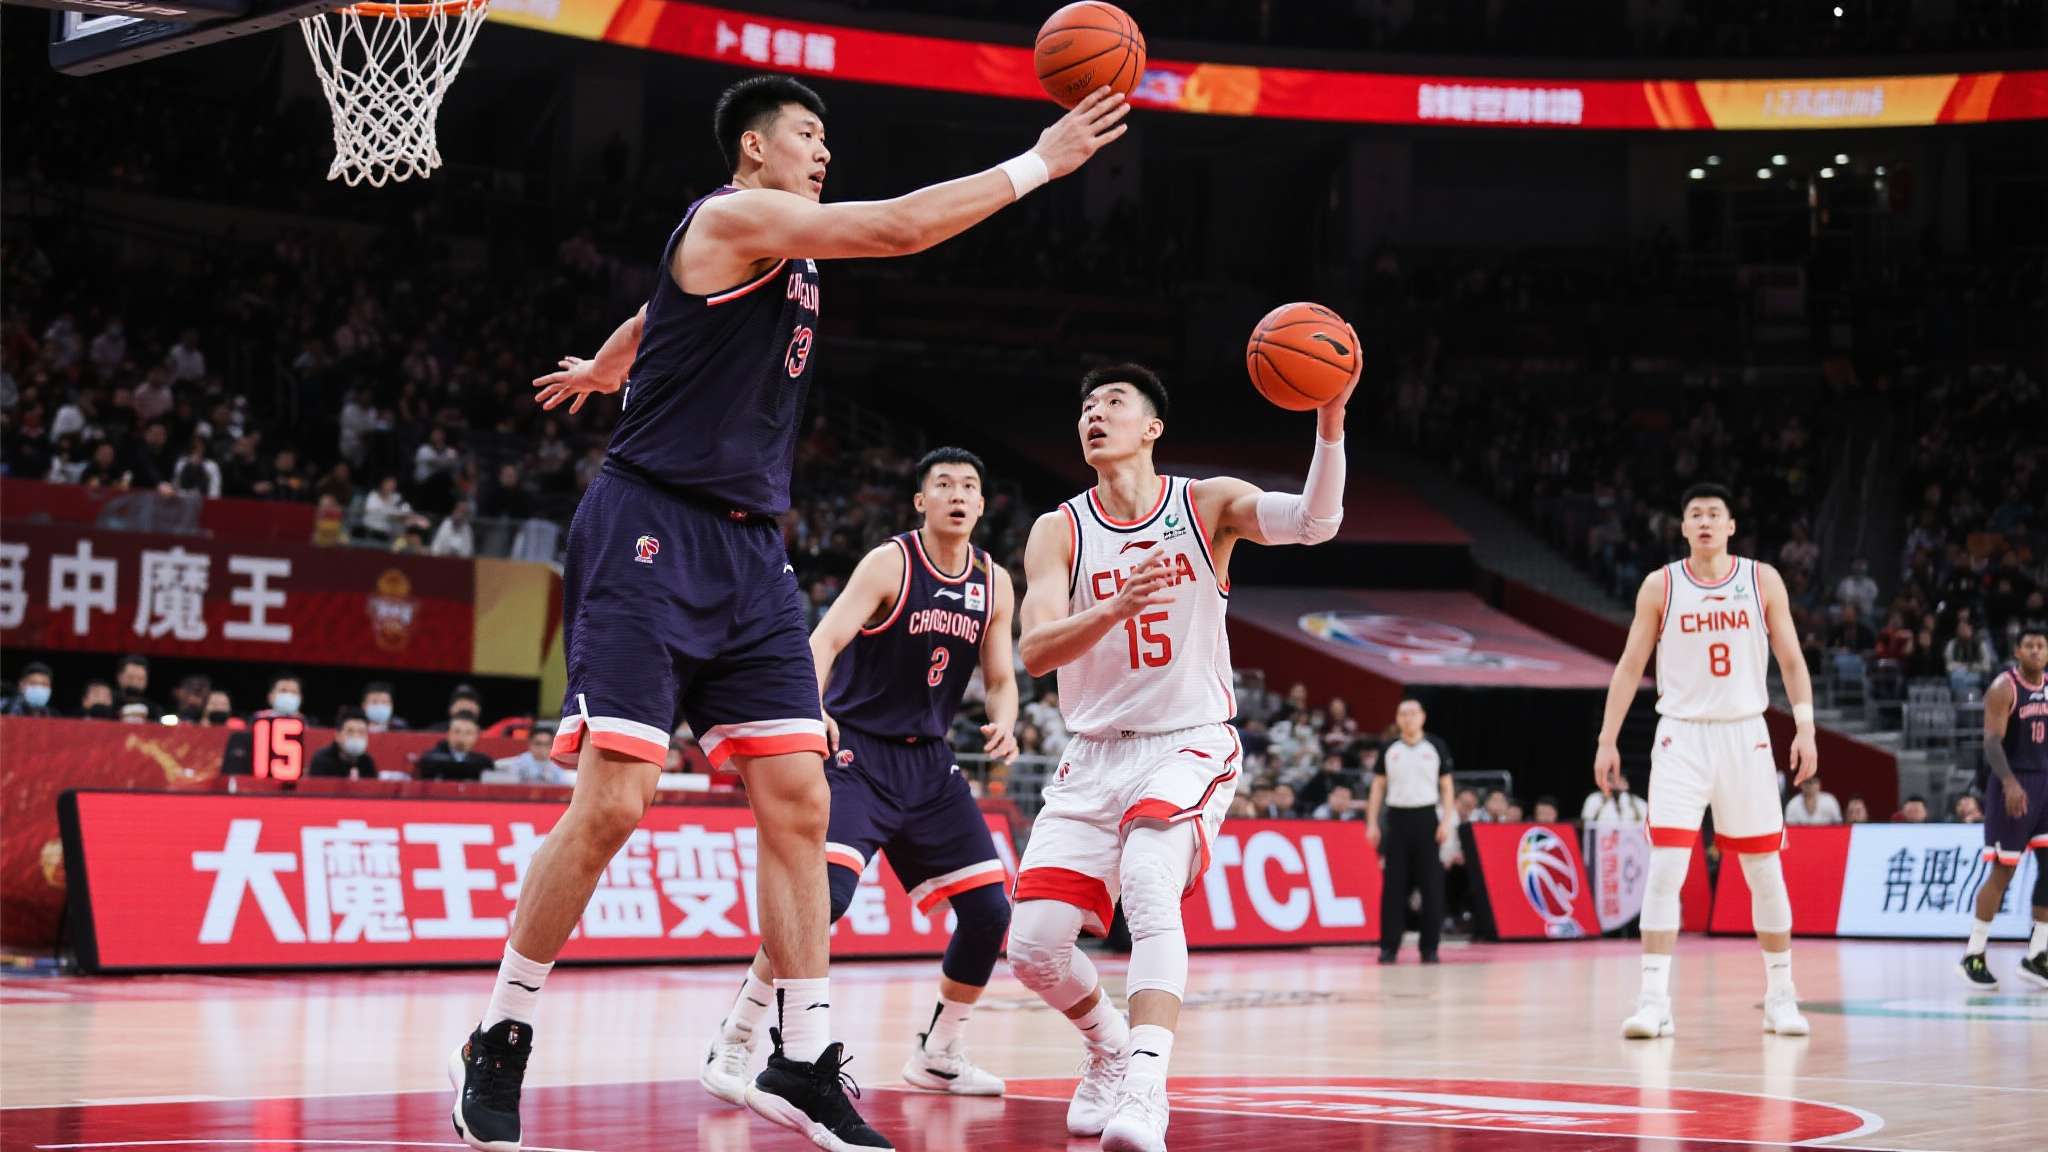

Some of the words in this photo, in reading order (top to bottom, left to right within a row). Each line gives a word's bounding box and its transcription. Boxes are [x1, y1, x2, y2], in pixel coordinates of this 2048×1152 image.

[1124, 611, 1172, 671] 15
[1680, 609, 1750, 633] CHINA
[1708, 642, 1731, 678] 8
[252, 717, 304, 781] 15
[2031, 720, 2045, 744] 10
[1203, 830, 1366, 932] TCL
